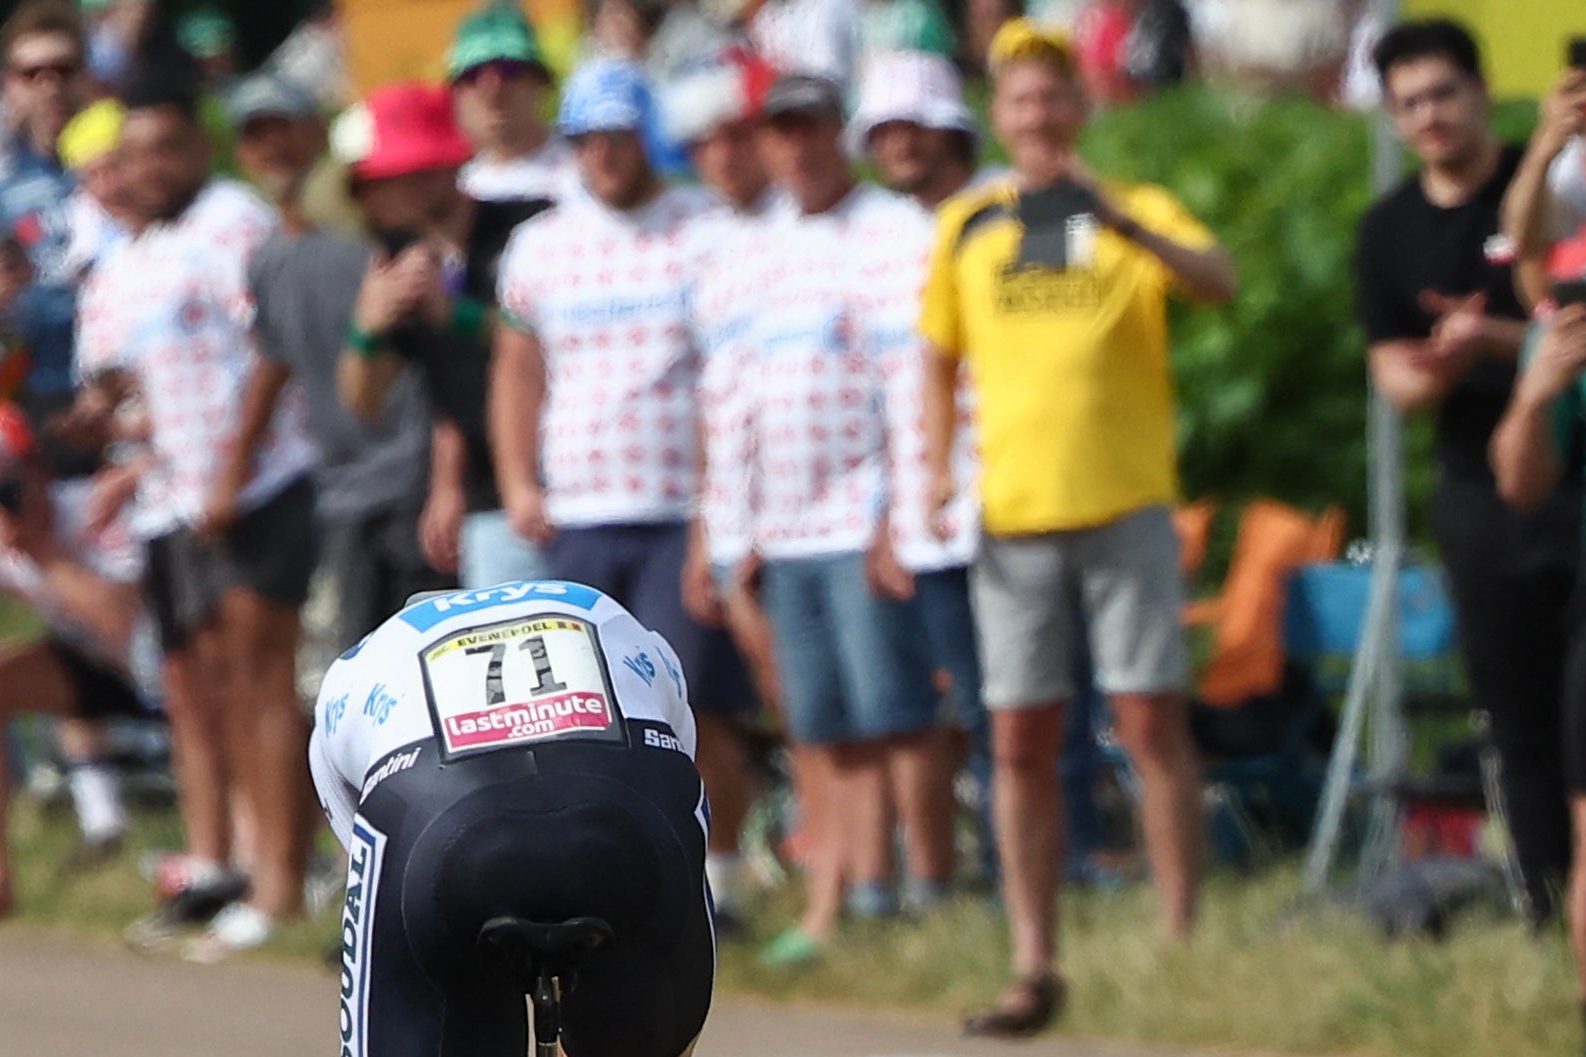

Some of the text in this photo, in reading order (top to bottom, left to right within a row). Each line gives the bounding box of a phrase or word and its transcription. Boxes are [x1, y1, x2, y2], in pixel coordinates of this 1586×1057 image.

[433, 583, 568, 613] Krys
[457, 622, 553, 648] EVENEPOEL
[464, 634, 568, 706] 71
[447, 695, 603, 737] lastminute
[507, 718, 555, 739] .com
